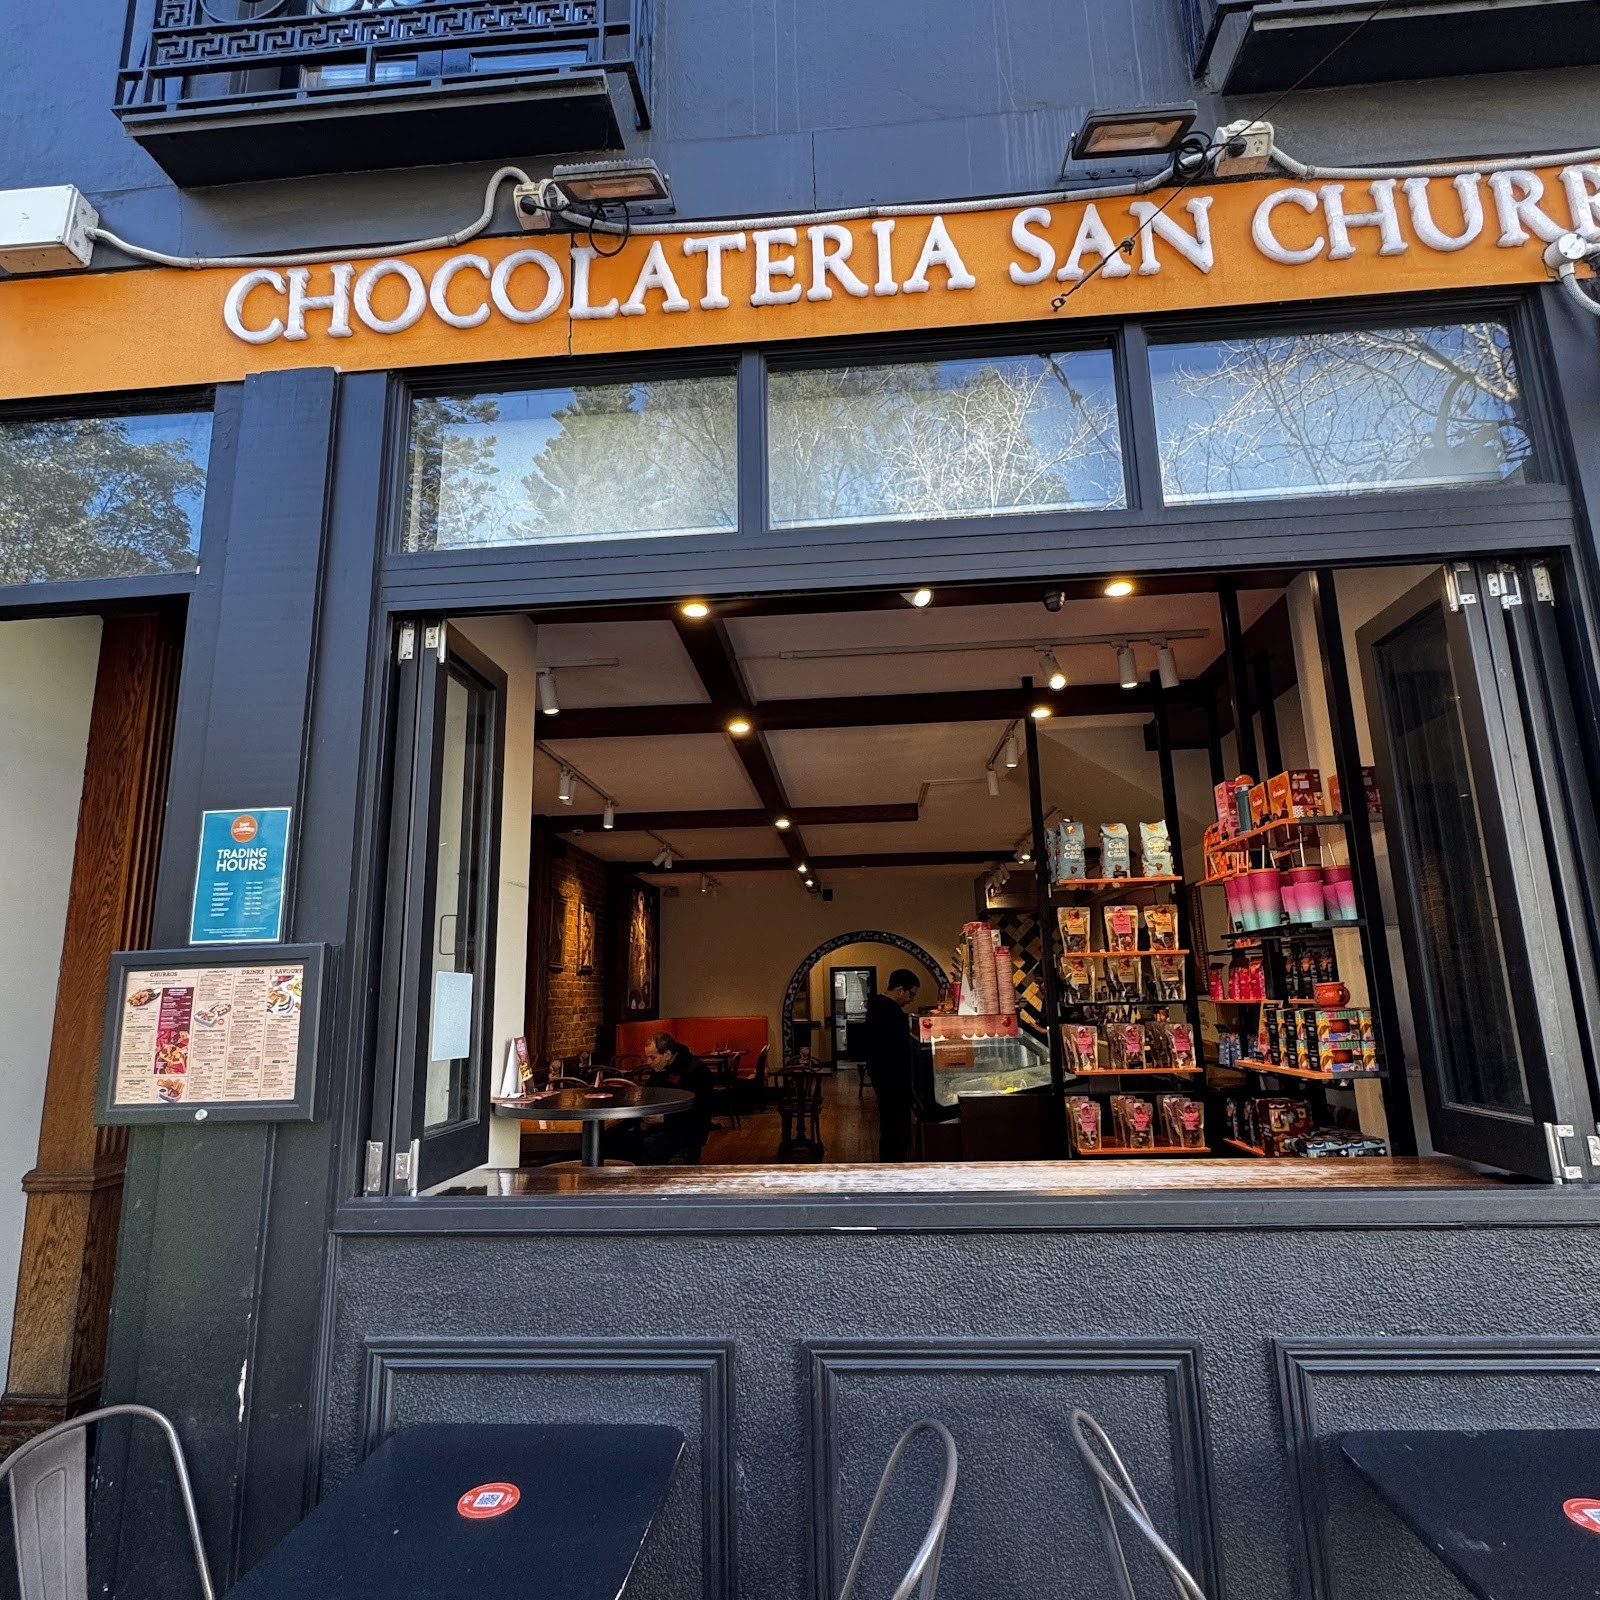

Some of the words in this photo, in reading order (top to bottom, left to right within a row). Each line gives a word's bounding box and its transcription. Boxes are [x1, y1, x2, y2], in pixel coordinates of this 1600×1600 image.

[223, 215, 976, 346] CHOCOLATERIA
[1009, 196, 1214, 285] SAN
[217, 847, 268, 860] TRADING
[216, 858, 267, 872] HOURS
